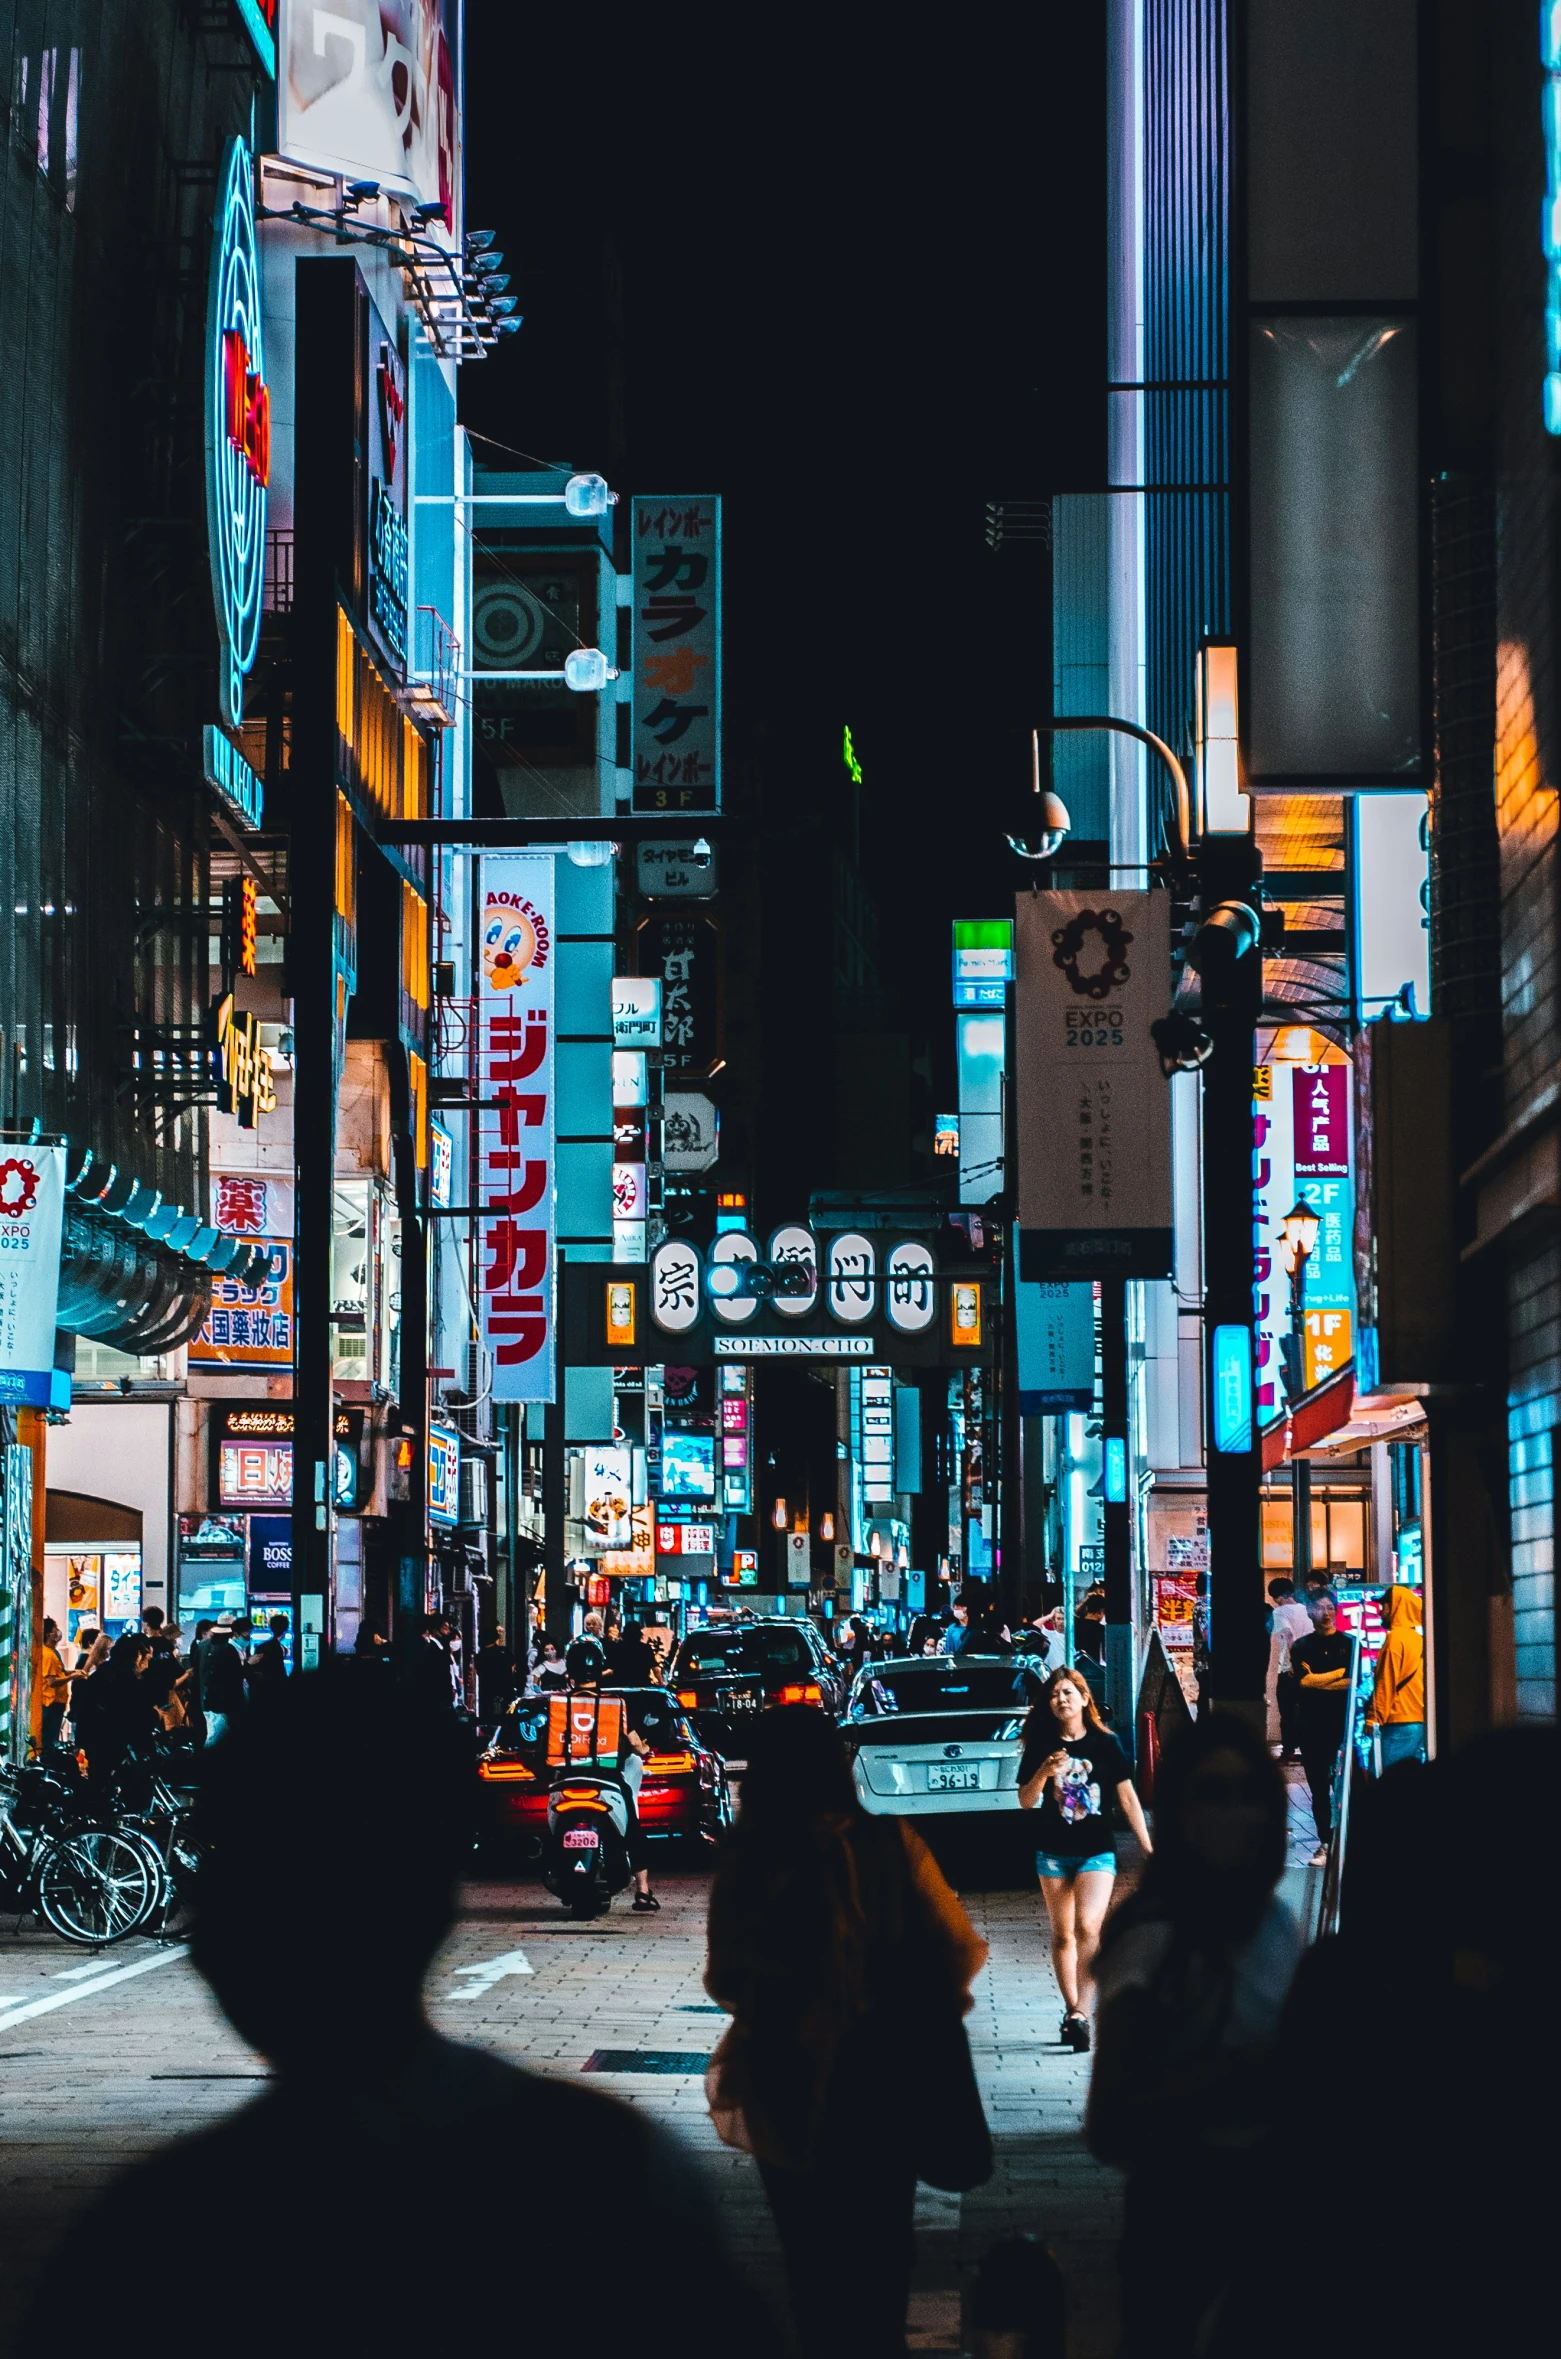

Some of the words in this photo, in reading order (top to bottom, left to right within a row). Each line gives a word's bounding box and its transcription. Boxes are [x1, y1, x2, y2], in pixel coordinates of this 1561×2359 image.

[638, 506, 713, 539] レインボー
[641, 545, 709, 746] カラオケ
[480, 717, 515, 741] 5F
[636, 749, 712, 786] レインボー
[665, 871, 689, 887] ビル
[1065, 1010, 1124, 1028] EXPO
[1065, 1029, 1124, 1047] 2025
[664, 1054, 692, 1068] 5F
[1311, 1079, 1331, 1152] 人气产品
[1296, 1163, 1316, 1173] Best
[1318, 1163, 1348, 1174] Selling
[484, 1009, 548, 1366] ジャンカラ
[1304, 1183, 1340, 1205] 2F
[217, 1176, 266, 1231] 薬
[0, 1226, 31, 1238] XPO
[0, 1238, 30, 1249] 025
[658, 1245, 929, 1312] 宗門町
[1040, 1289, 1070, 1299] 2025
[1304, 1294, 1350, 1305] rug+Life
[1307, 1313, 1343, 1337] 1F
[718, 1339, 869, 1352] SOEMON-CHO
[740, 1554, 753, 1569] P
[732, 1699, 757, 1710] 18-04
[559, 1732, 581, 1745] DDi
[582, 1733, 607, 1746] Fd
[940, 1773, 978, 1788] 96-19
[571, 1837, 596, 1847] 3206
